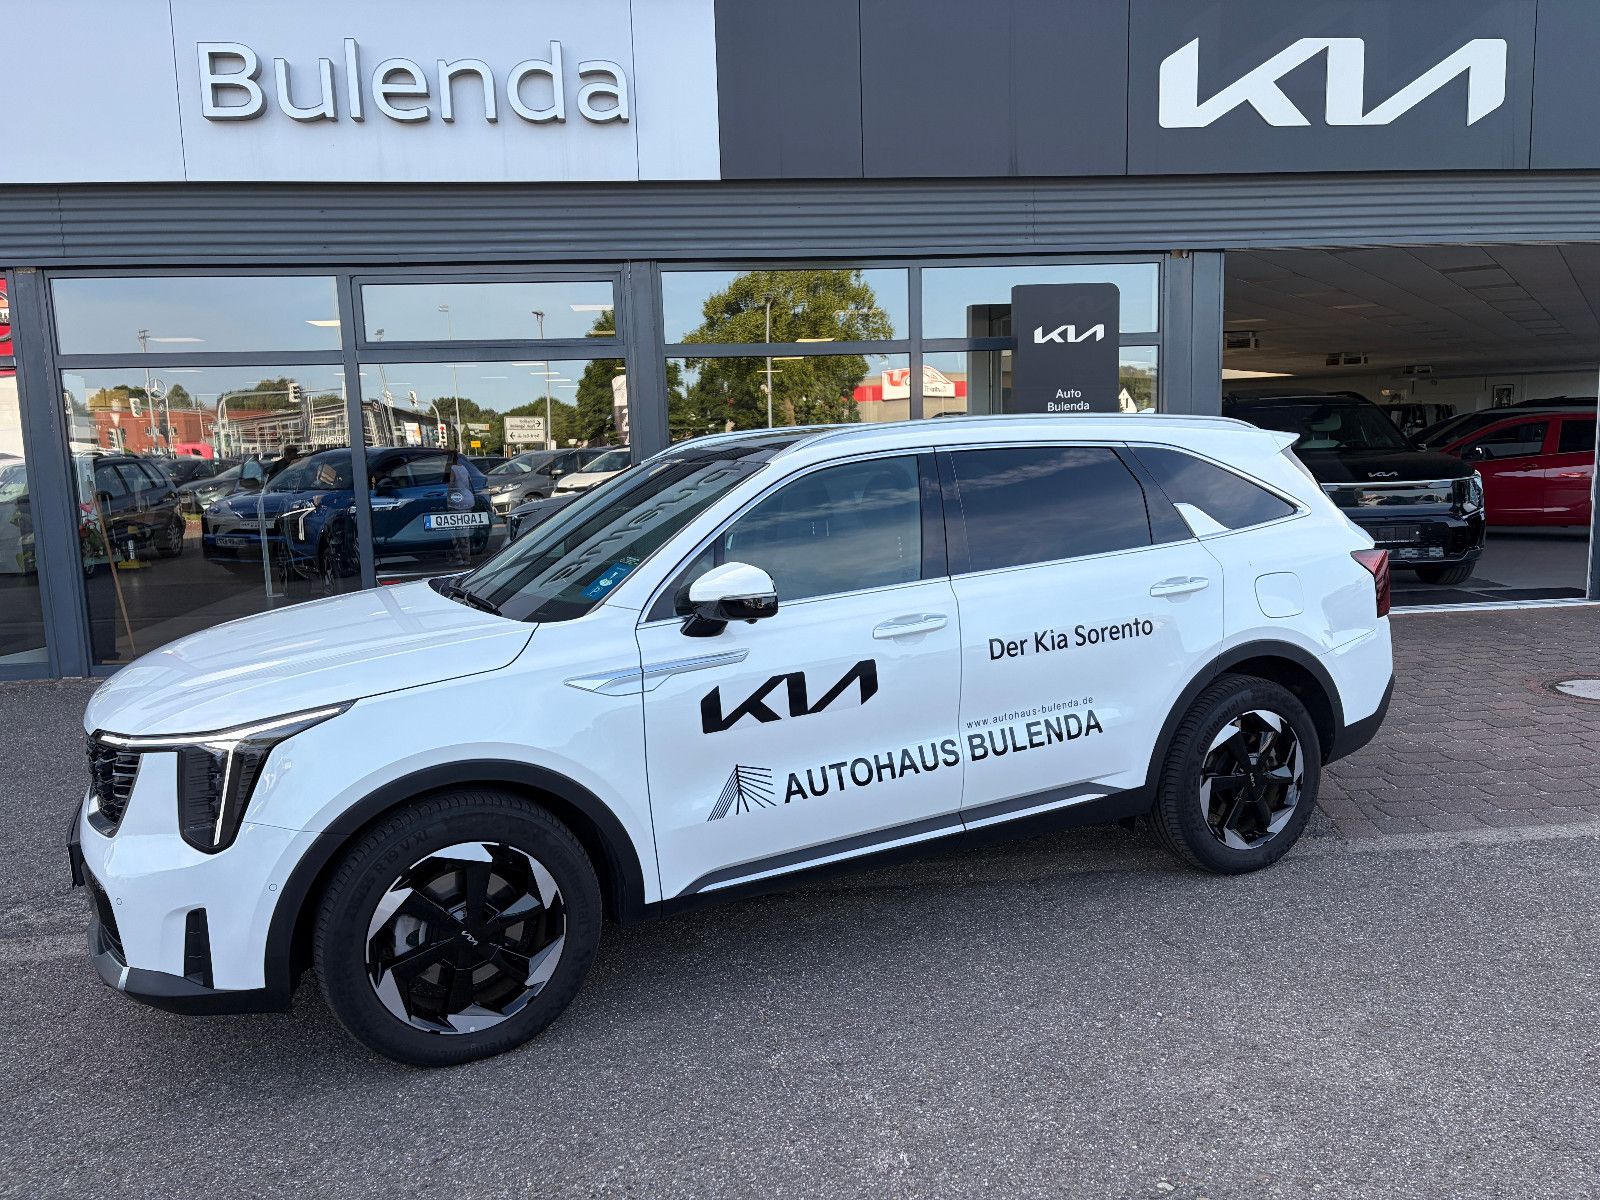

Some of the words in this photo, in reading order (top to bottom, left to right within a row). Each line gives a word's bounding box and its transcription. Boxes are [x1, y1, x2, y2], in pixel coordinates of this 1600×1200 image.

[196, 38, 629, 124] Bulenda
[1159, 37, 1507, 128] KIA
[1033, 323, 1105, 344] KIA
[1047, 401, 1090, 412] Bulenda
[1055, 388, 1082, 399] Auto
[435, 513, 484, 526] QASHQAI
[988, 637, 1028, 660] Der
[1034, 629, 1069, 653] Kia
[1074, 617, 1154, 647] Sorento
[700, 658, 879, 734] KIA
[966, 696, 1094, 729] www.autohaus-bulenda.de
[784, 739, 960, 804] AUTOHAUS
[967, 709, 1104, 762] BULENDA
